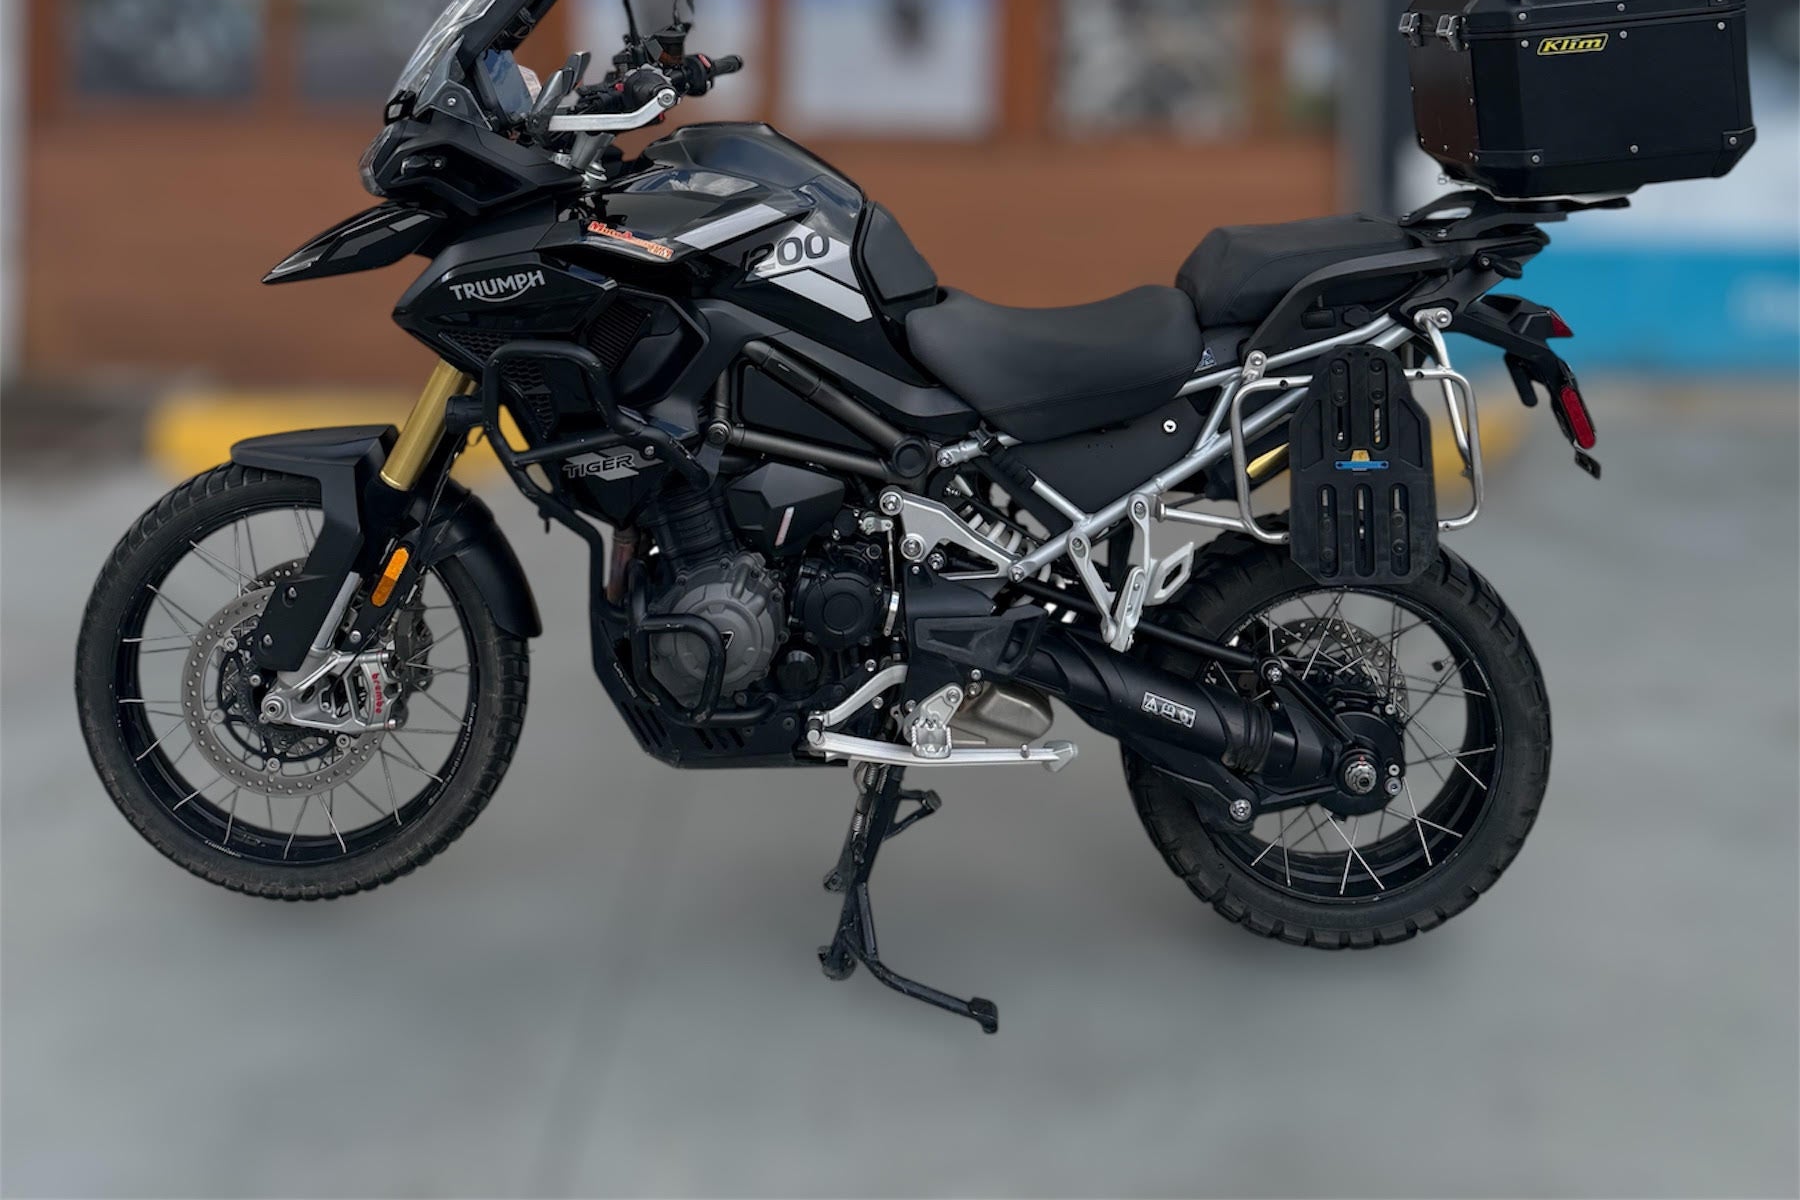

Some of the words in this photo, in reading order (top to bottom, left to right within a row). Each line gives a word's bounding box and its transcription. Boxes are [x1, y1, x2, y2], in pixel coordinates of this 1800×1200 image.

[1542, 39, 1602, 52] Klim
[449, 270, 546, 302] TRIUMPH
[562, 453, 636, 479] TIGER
